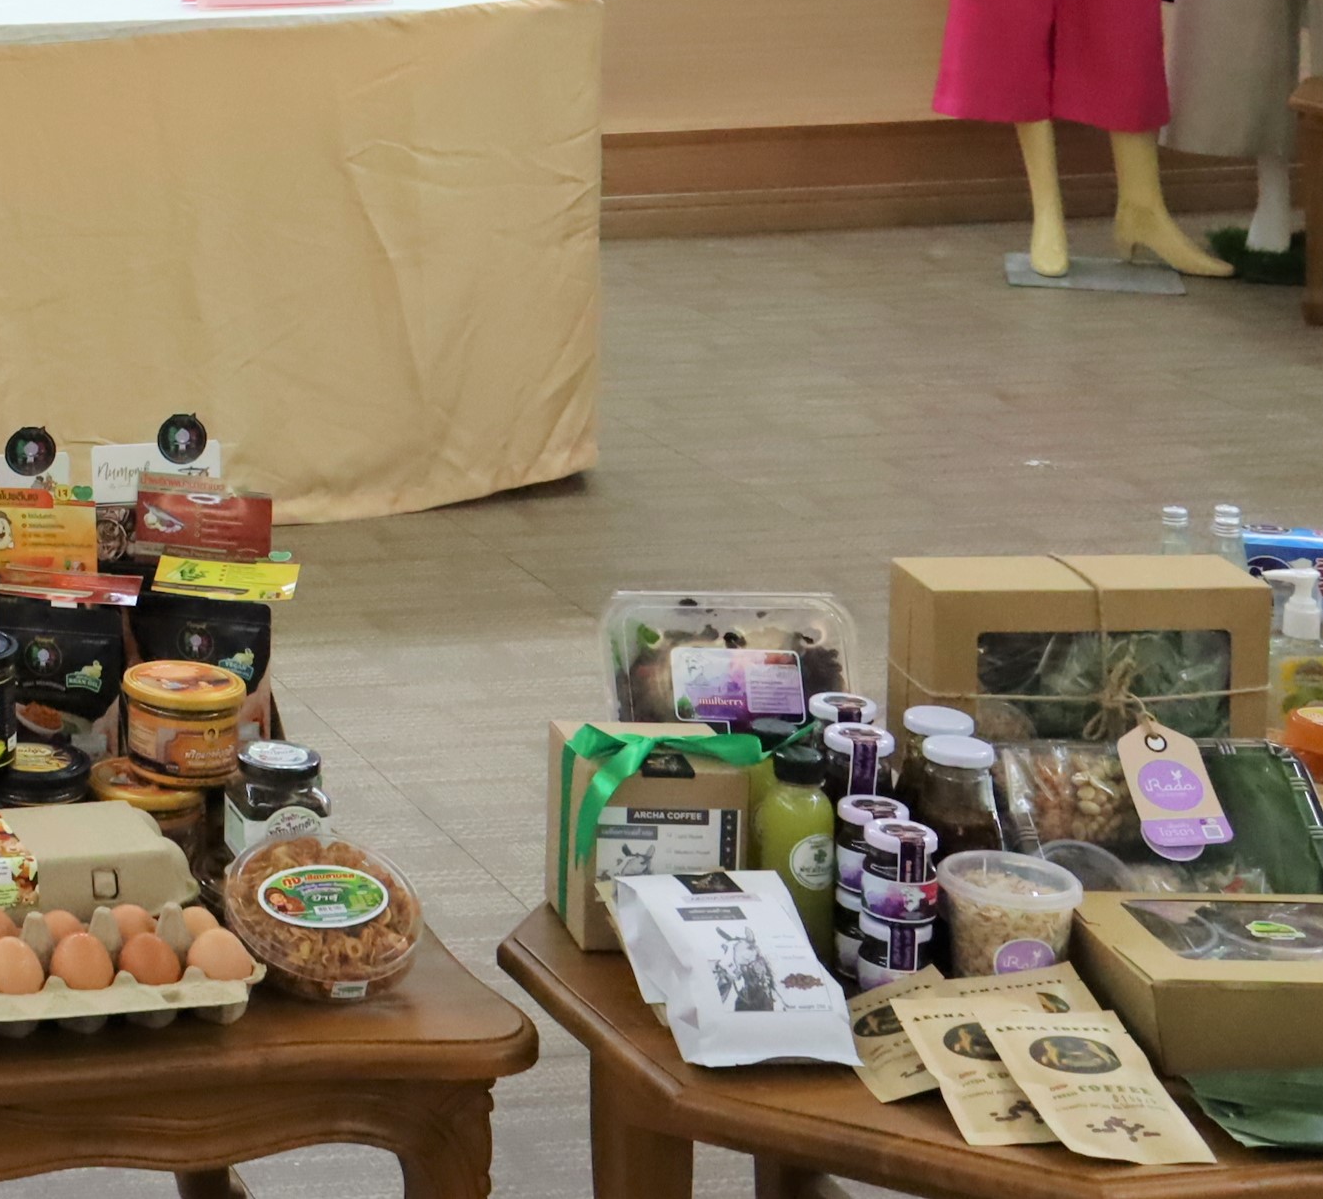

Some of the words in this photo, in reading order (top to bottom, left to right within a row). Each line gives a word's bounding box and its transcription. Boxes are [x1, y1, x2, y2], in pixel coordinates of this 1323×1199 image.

[698, 696, 744, 707] mulberry
[634, 811, 665, 820] ARCHA
[666, 811, 702, 821] COFFEE
[1007, 979, 1065, 990] COFFEE
[912, 1010, 966, 1023] ARCHA
[994, 1024, 1049, 1035] ARCHA
[1052, 1024, 1111, 1034] COFFEE
